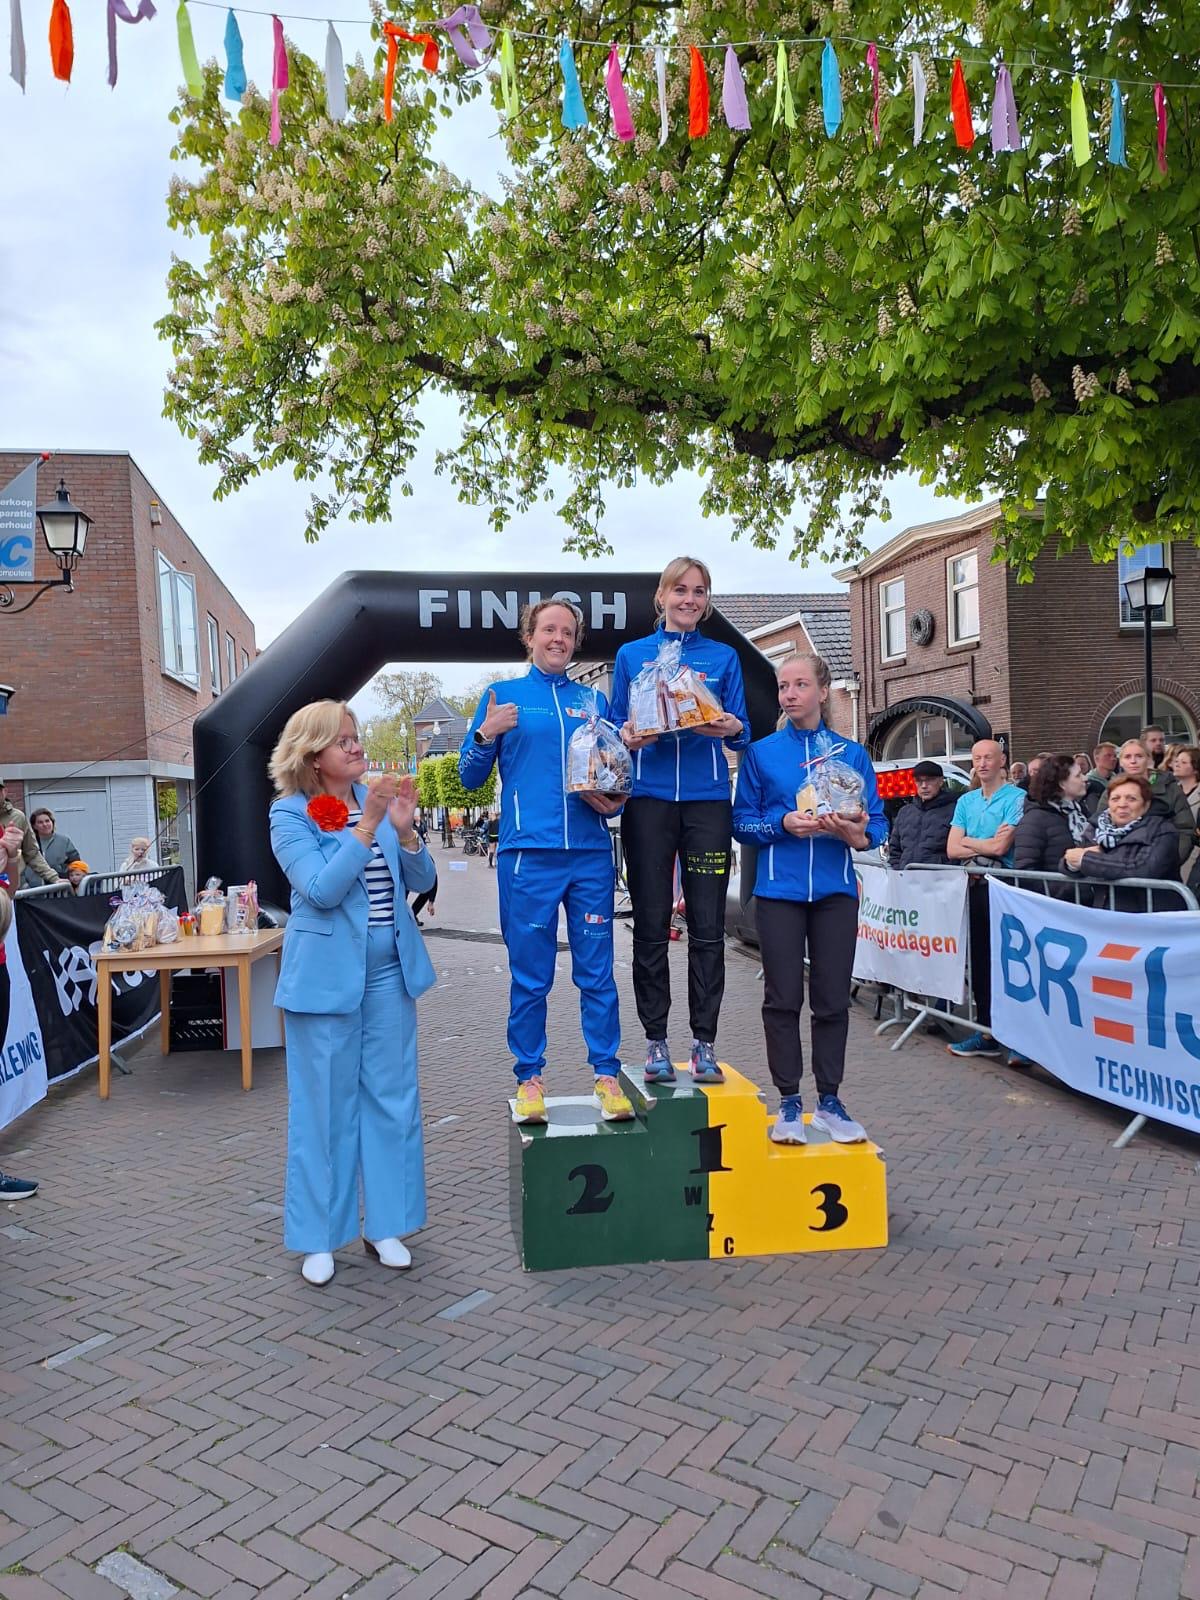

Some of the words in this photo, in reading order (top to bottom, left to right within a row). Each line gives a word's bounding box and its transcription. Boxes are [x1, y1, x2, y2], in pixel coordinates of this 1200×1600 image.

[690, 1124, 733, 1174] 1
[566, 1164, 615, 1215] 2
[684, 1186, 702, 1206] W
[808, 1182, 849, 1232] 3
[723, 1236, 735, 1255] C
